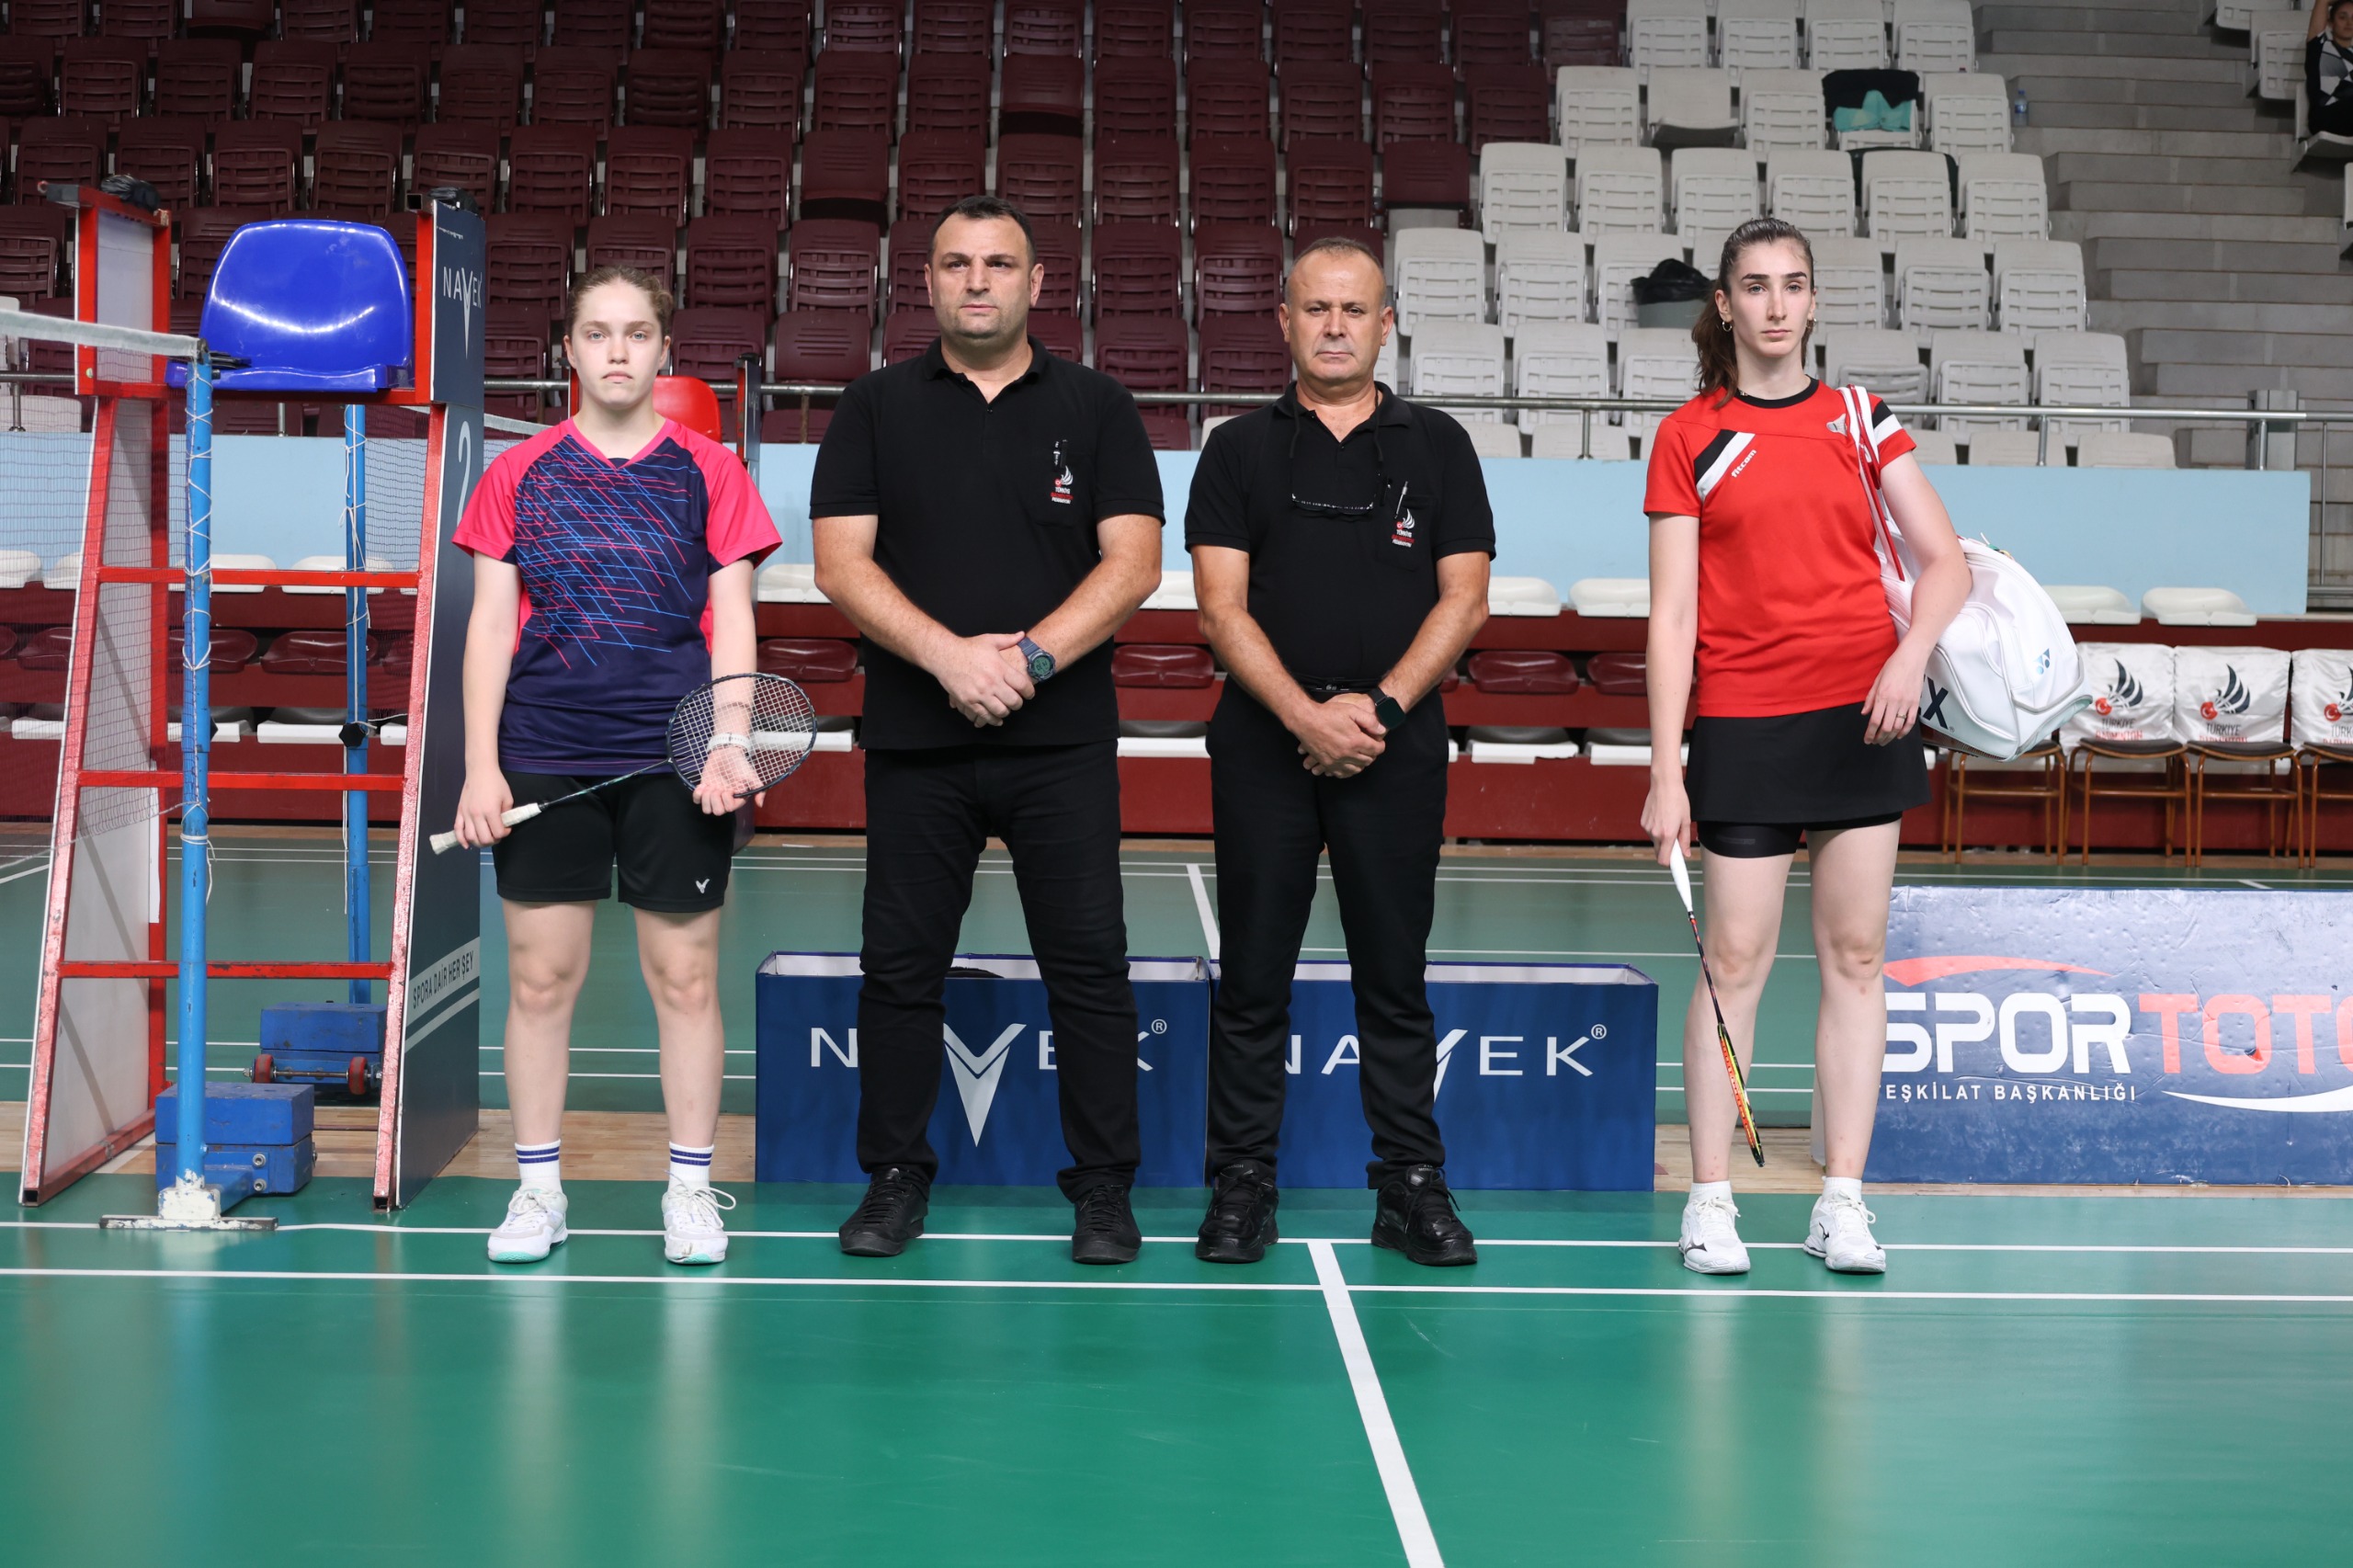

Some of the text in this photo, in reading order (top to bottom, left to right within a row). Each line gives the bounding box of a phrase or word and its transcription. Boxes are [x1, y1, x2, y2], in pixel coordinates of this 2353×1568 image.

[448, 958, 460, 984] HER
[2138, 993, 2353, 1074] TOT
[1880, 1081, 2136, 1105] EŞKİLAT BAŞKANLIĞI
